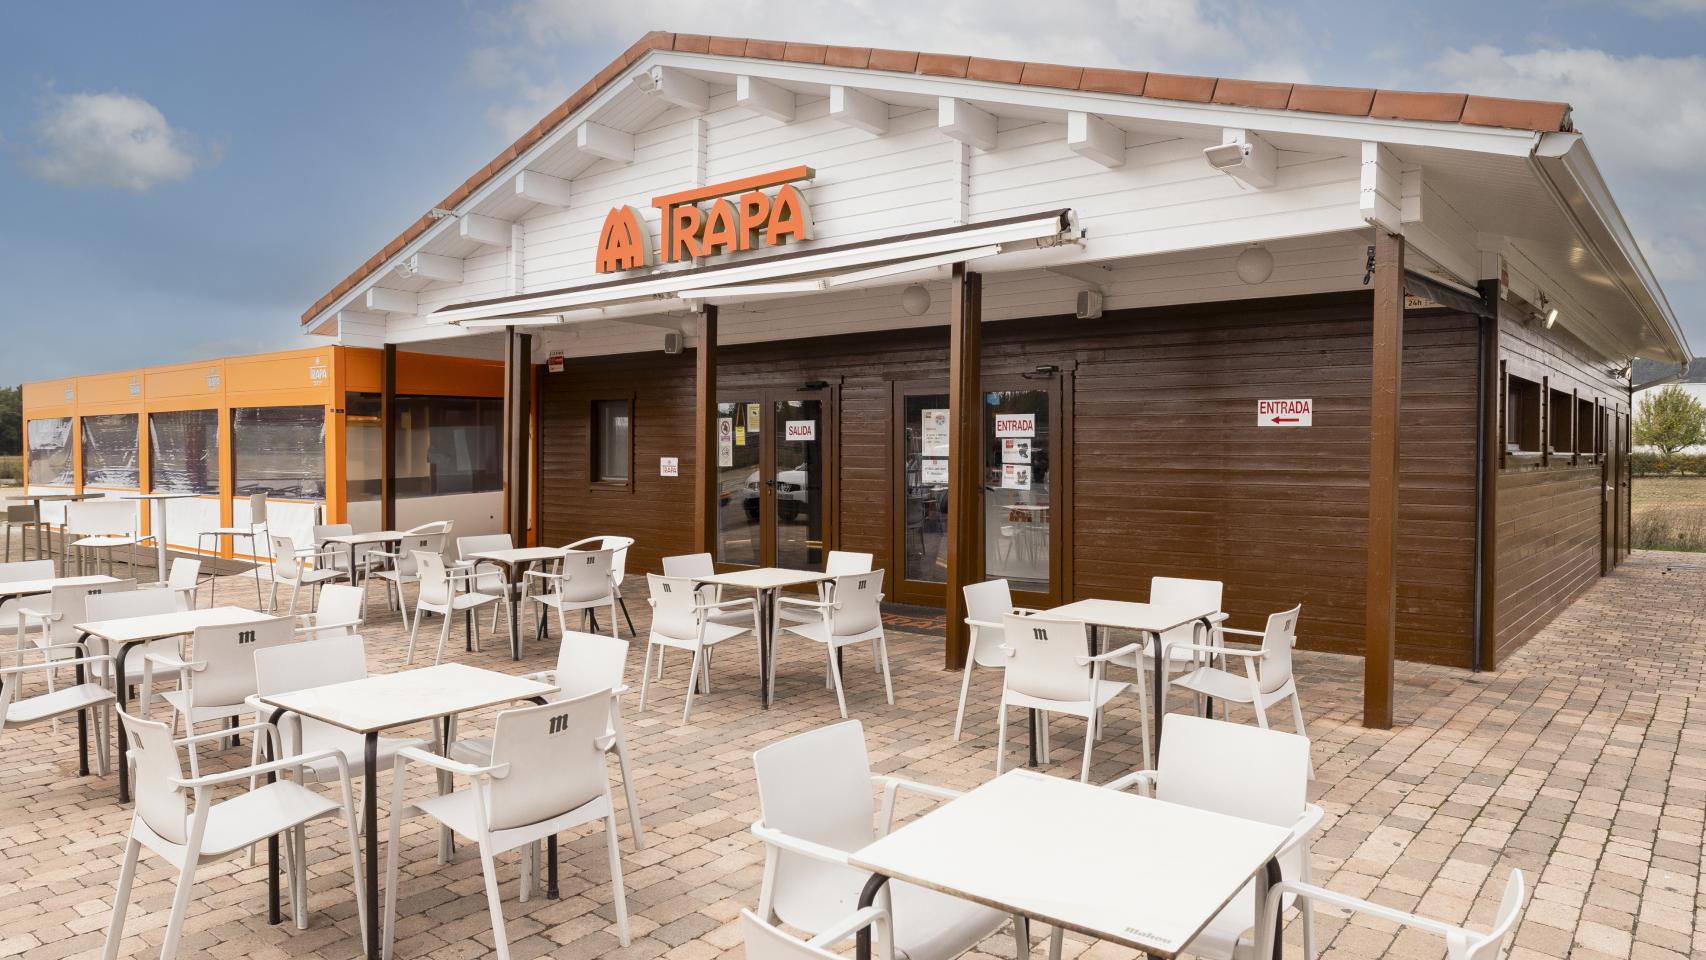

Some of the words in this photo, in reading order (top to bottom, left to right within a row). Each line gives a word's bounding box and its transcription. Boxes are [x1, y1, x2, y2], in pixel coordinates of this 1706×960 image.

[652, 165, 814, 263] TRAPA
[1260, 400, 1310, 414] ENTRADA
[789, 425, 812, 435] SALIDA
[997, 420, 1033, 431] ENTRADA
[549, 713, 568, 734] m
